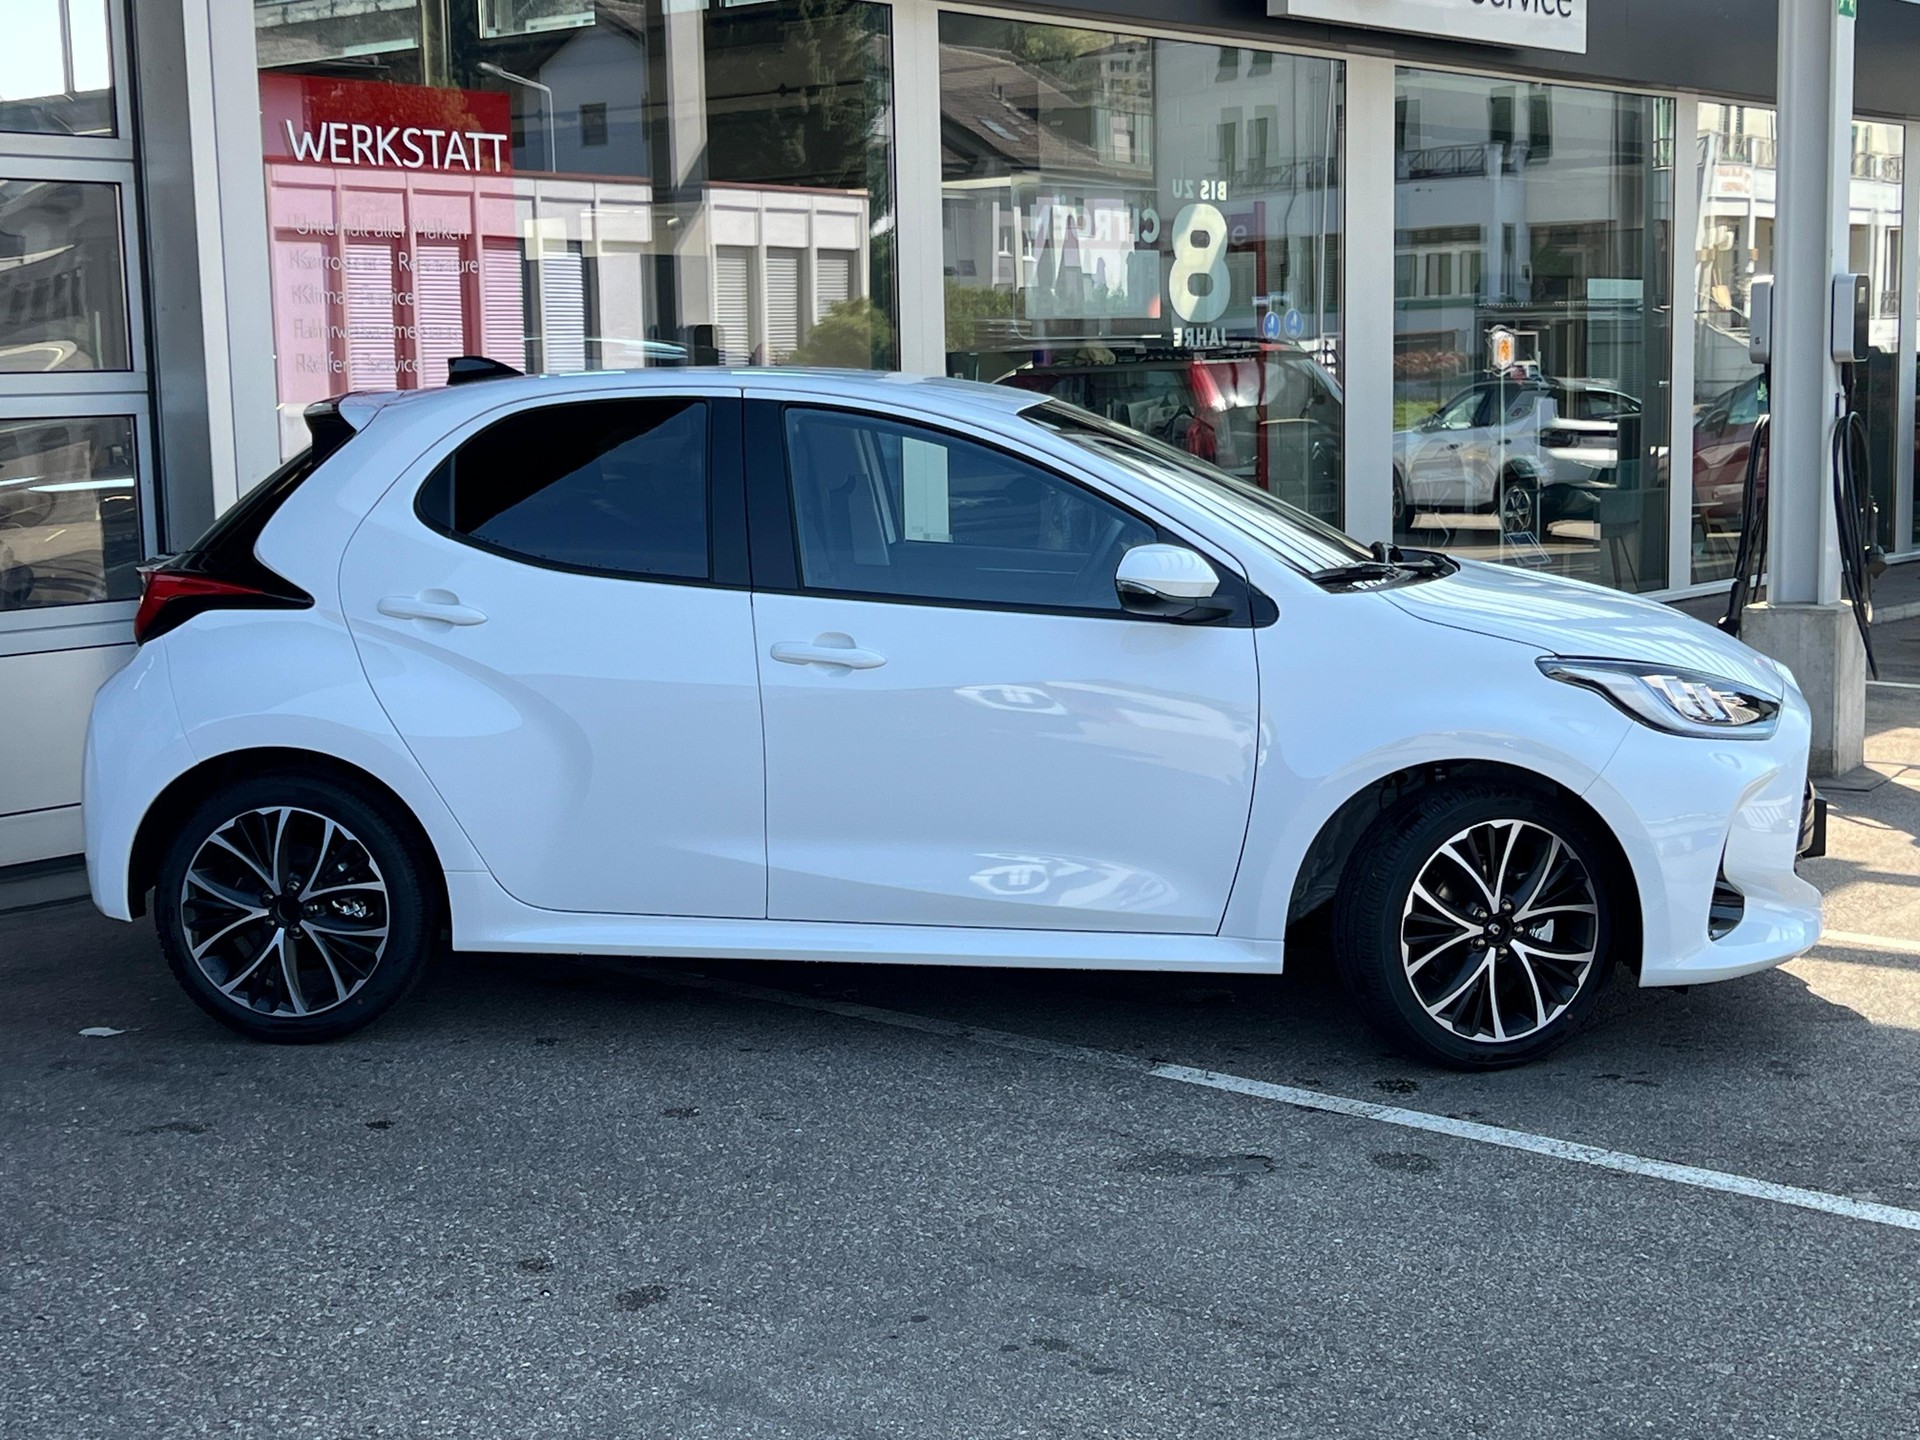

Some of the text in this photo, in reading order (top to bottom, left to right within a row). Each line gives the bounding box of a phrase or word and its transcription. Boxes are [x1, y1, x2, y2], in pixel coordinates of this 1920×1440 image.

[1470, 0, 1572, 18] rvice
[286, 119, 508, 173] WERKSTATT
[411, 218, 469, 242] Marken
